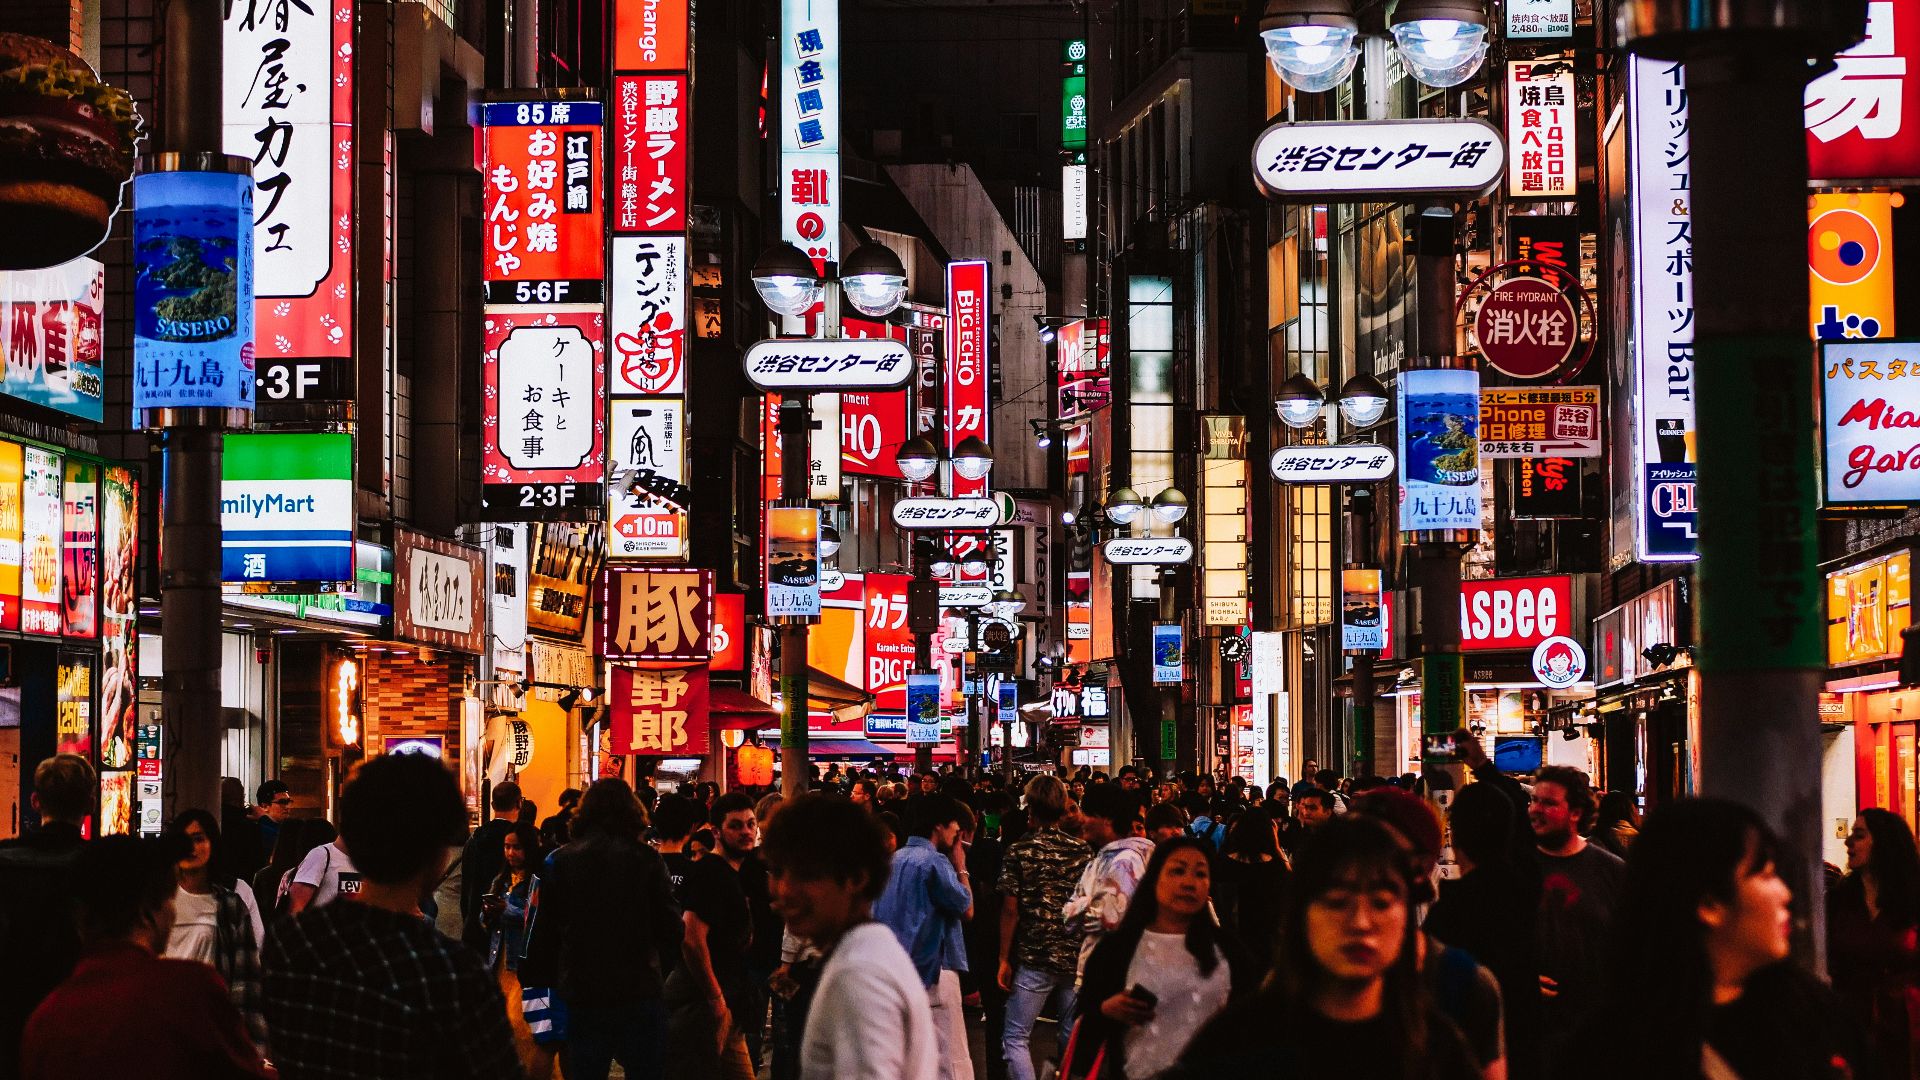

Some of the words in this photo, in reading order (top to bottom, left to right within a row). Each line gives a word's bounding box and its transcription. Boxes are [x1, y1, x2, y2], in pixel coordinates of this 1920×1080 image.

[1511, 13, 1569, 24] 焼肉食べ放題
[1076, 64, 1084, 74] 5
[1515, 65, 1532, 82] 2
[795, 28, 824, 144] 現金問屋
[644, 79, 680, 227] 野郎ラーメン
[1077, 152, 1085, 163] 4
[1267, 141, 1492, 173] 渋谷センター街
[566, 136, 589, 210] 江戸前
[526, 130, 557, 253] お好み焼
[491, 165, 521, 276] もんじゃ
[957, 290, 975, 328] BIG
[1493, 291, 1514, 302] FIRE
[1517, 291, 1559, 303] HYDRANT
[155, 315, 231, 337] SASEBO
[1485, 307, 1567, 347] 消火栓
[136, 358, 225, 388] 九十九島
[753, 352, 904, 373] 渋谷センター街
[958, 330, 976, 387] ECHO
[551, 336, 571, 431] ケーキと
[521, 384, 545, 459] お食事
[1558, 408, 1589, 423] 渋谷
[1277, 455, 1389, 471] 渋谷センター街
[1434, 467, 1478, 482] SASEBO
[897, 507, 993, 519] 渋谷センター街
[1412, 496, 1477, 517] 九十九島
[243, 554, 266, 577] 酒
[1109, 546, 1187, 557] 渋谷センター街
[615, 572, 702, 653] 豚
[769, 593, 814, 607] 九十九島
[876, 642, 900, 653] Karaoke
[869, 656, 902, 690] BIG
[630, 669, 689, 752] 野郎
[1080, 686, 1107, 717] 福
[511, 720, 529, 766] 豚野郎
